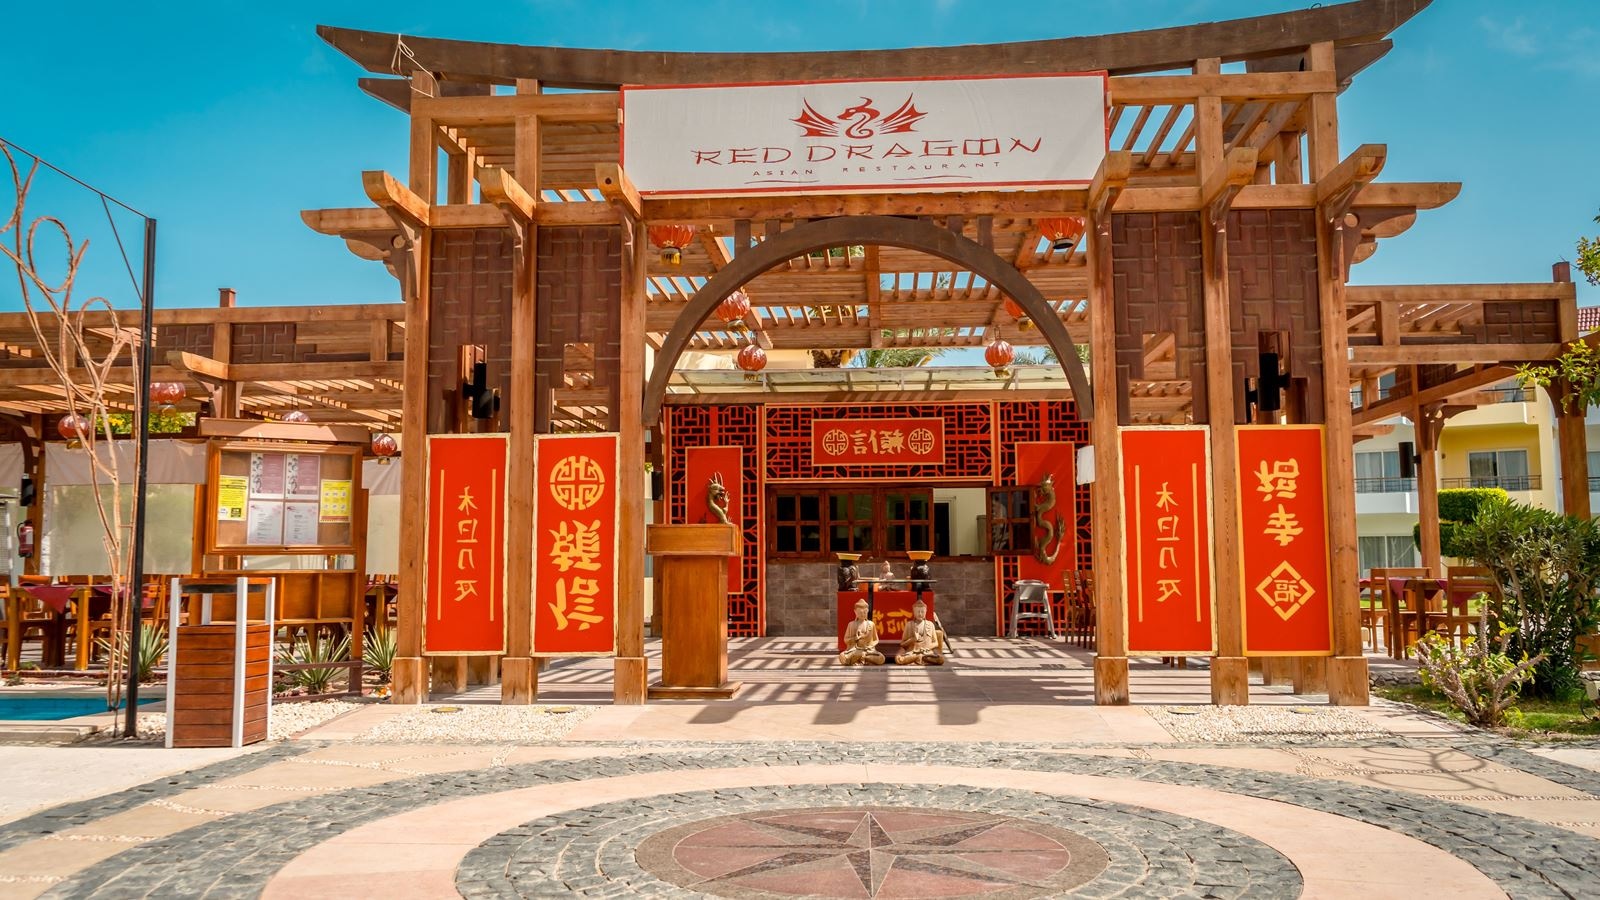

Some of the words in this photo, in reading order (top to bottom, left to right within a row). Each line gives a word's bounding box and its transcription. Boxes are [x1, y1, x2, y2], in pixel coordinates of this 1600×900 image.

[691, 147, 792, 166] RED
[806, 137, 1042, 162] DRAGON
[752, 169, 814, 177] ASIAN
[842, 161, 1001, 173] RESTAURANT
